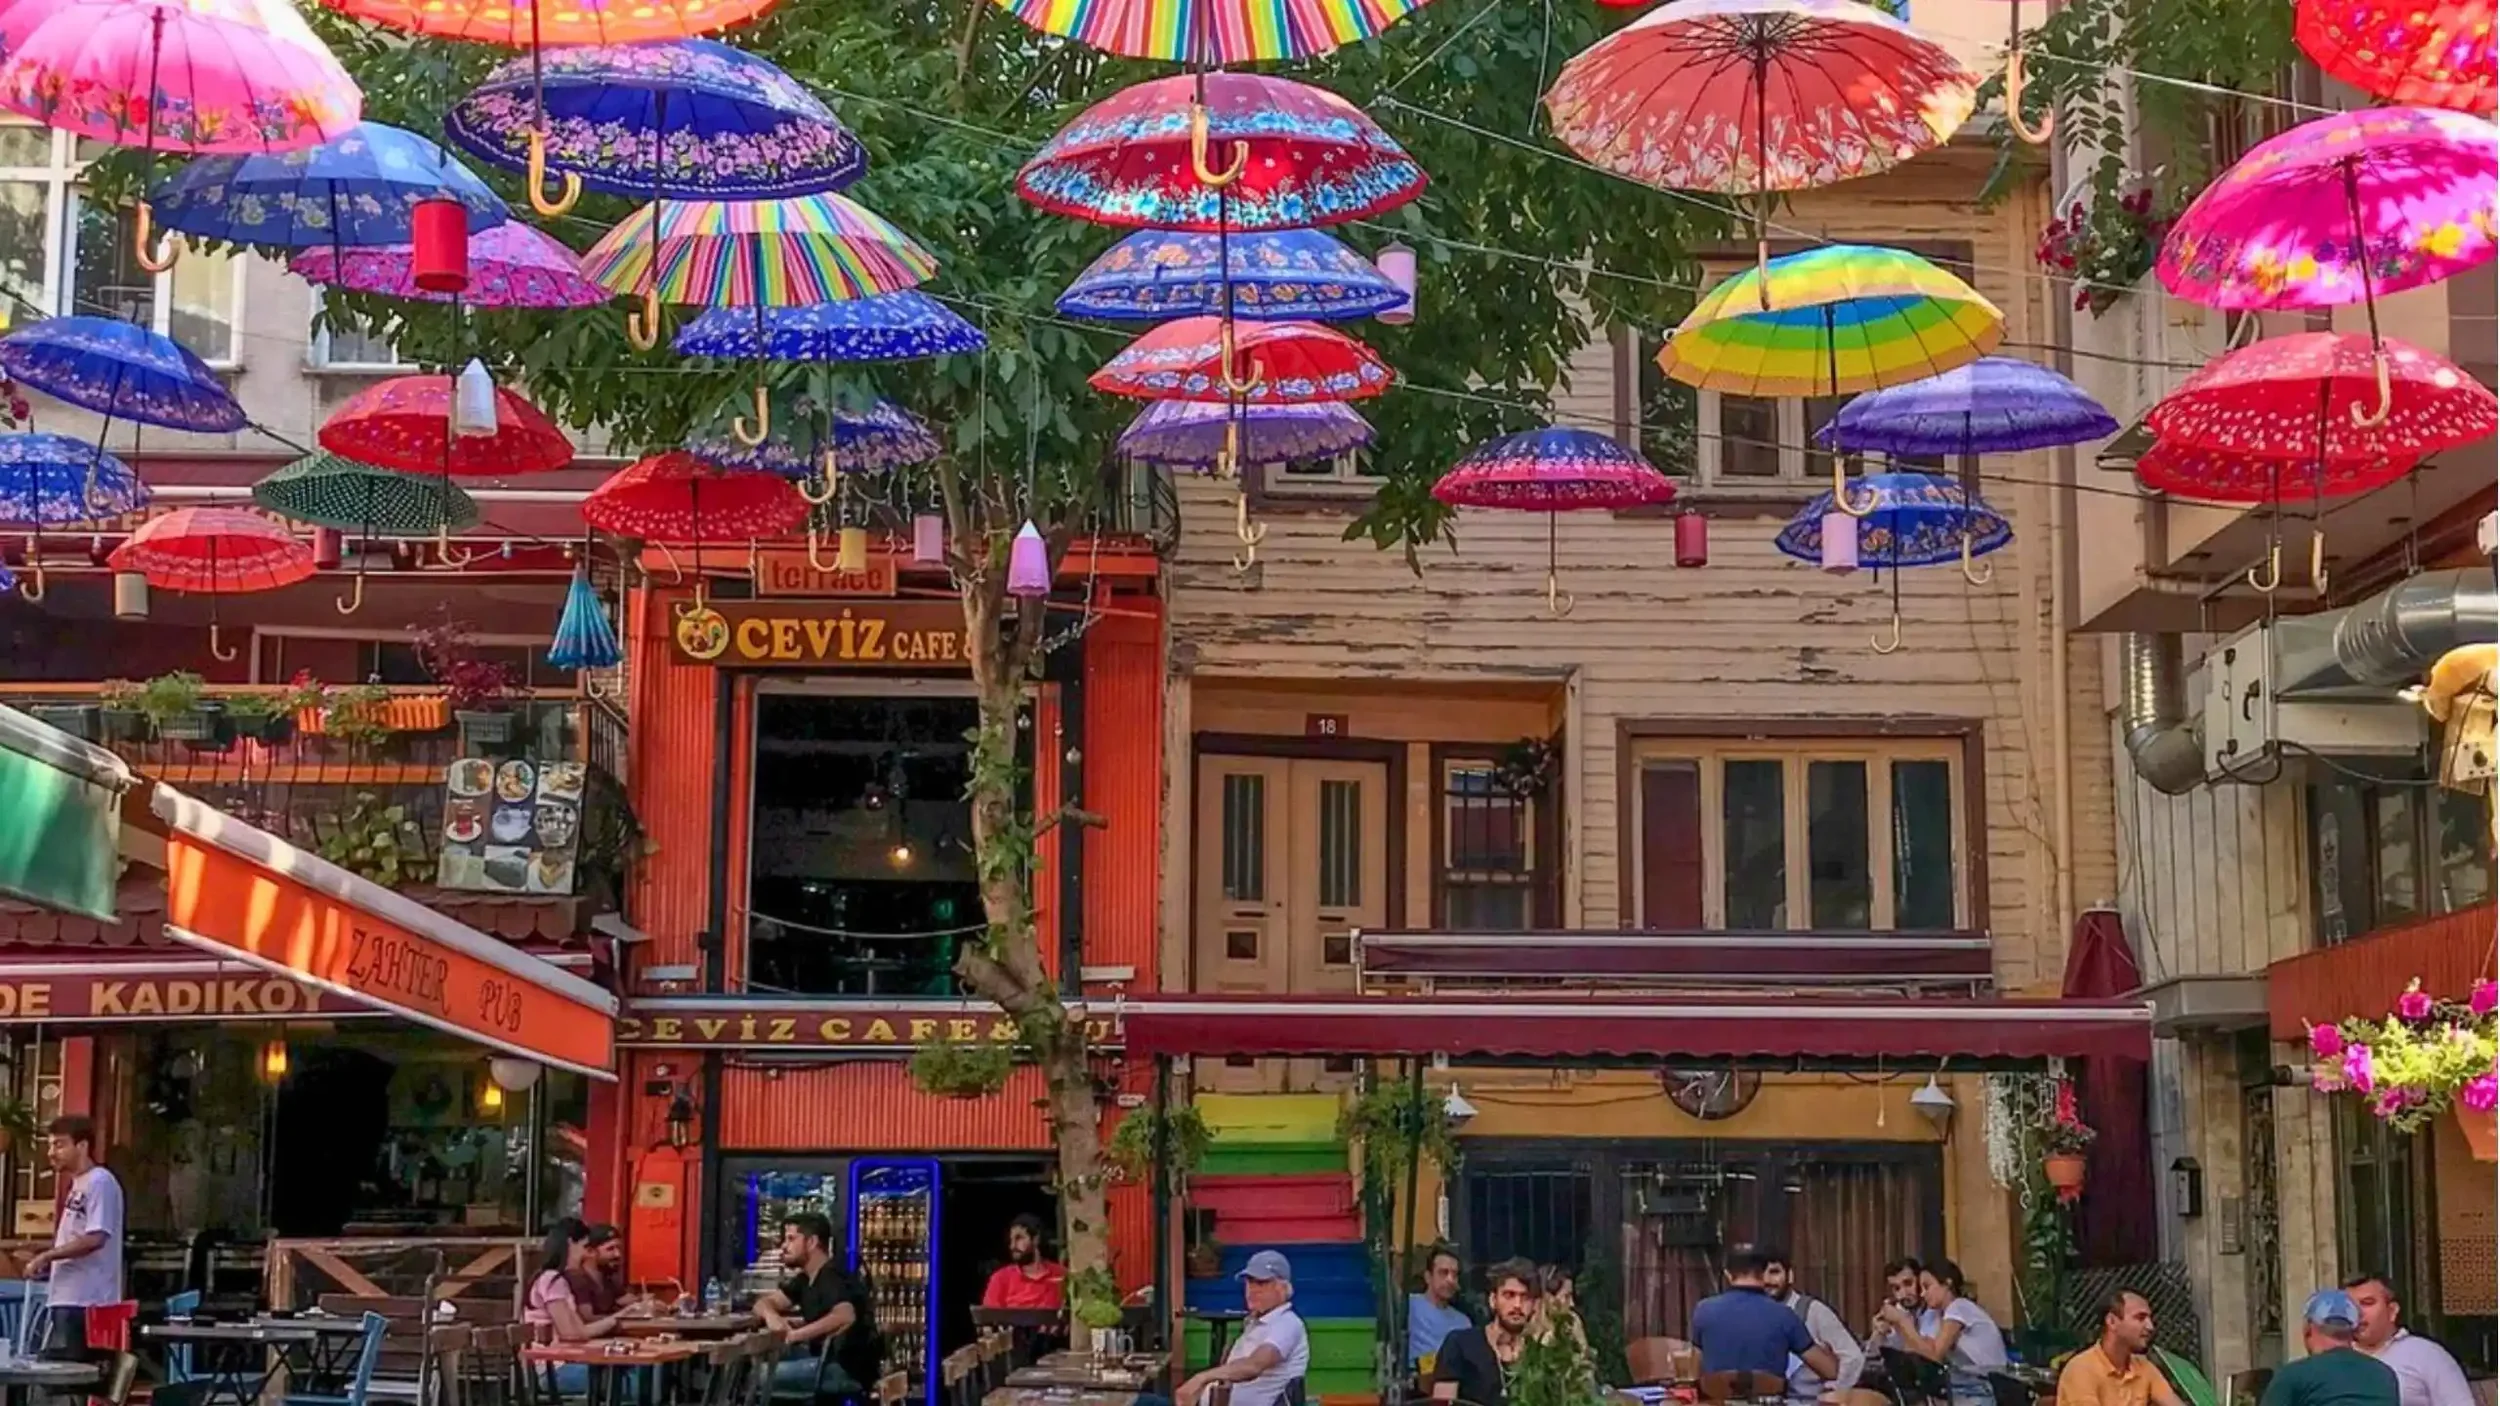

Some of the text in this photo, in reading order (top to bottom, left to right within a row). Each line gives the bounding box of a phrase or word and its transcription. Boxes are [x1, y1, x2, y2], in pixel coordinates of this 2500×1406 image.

[736, 608, 886, 659] CEVİZ
[893, 630, 957, 660] CAFE
[1317, 718, 1337, 735] 18
[345, 928, 522, 1033] ZAHTER PUB
[617, 1014, 796, 1041] CEVİZ
